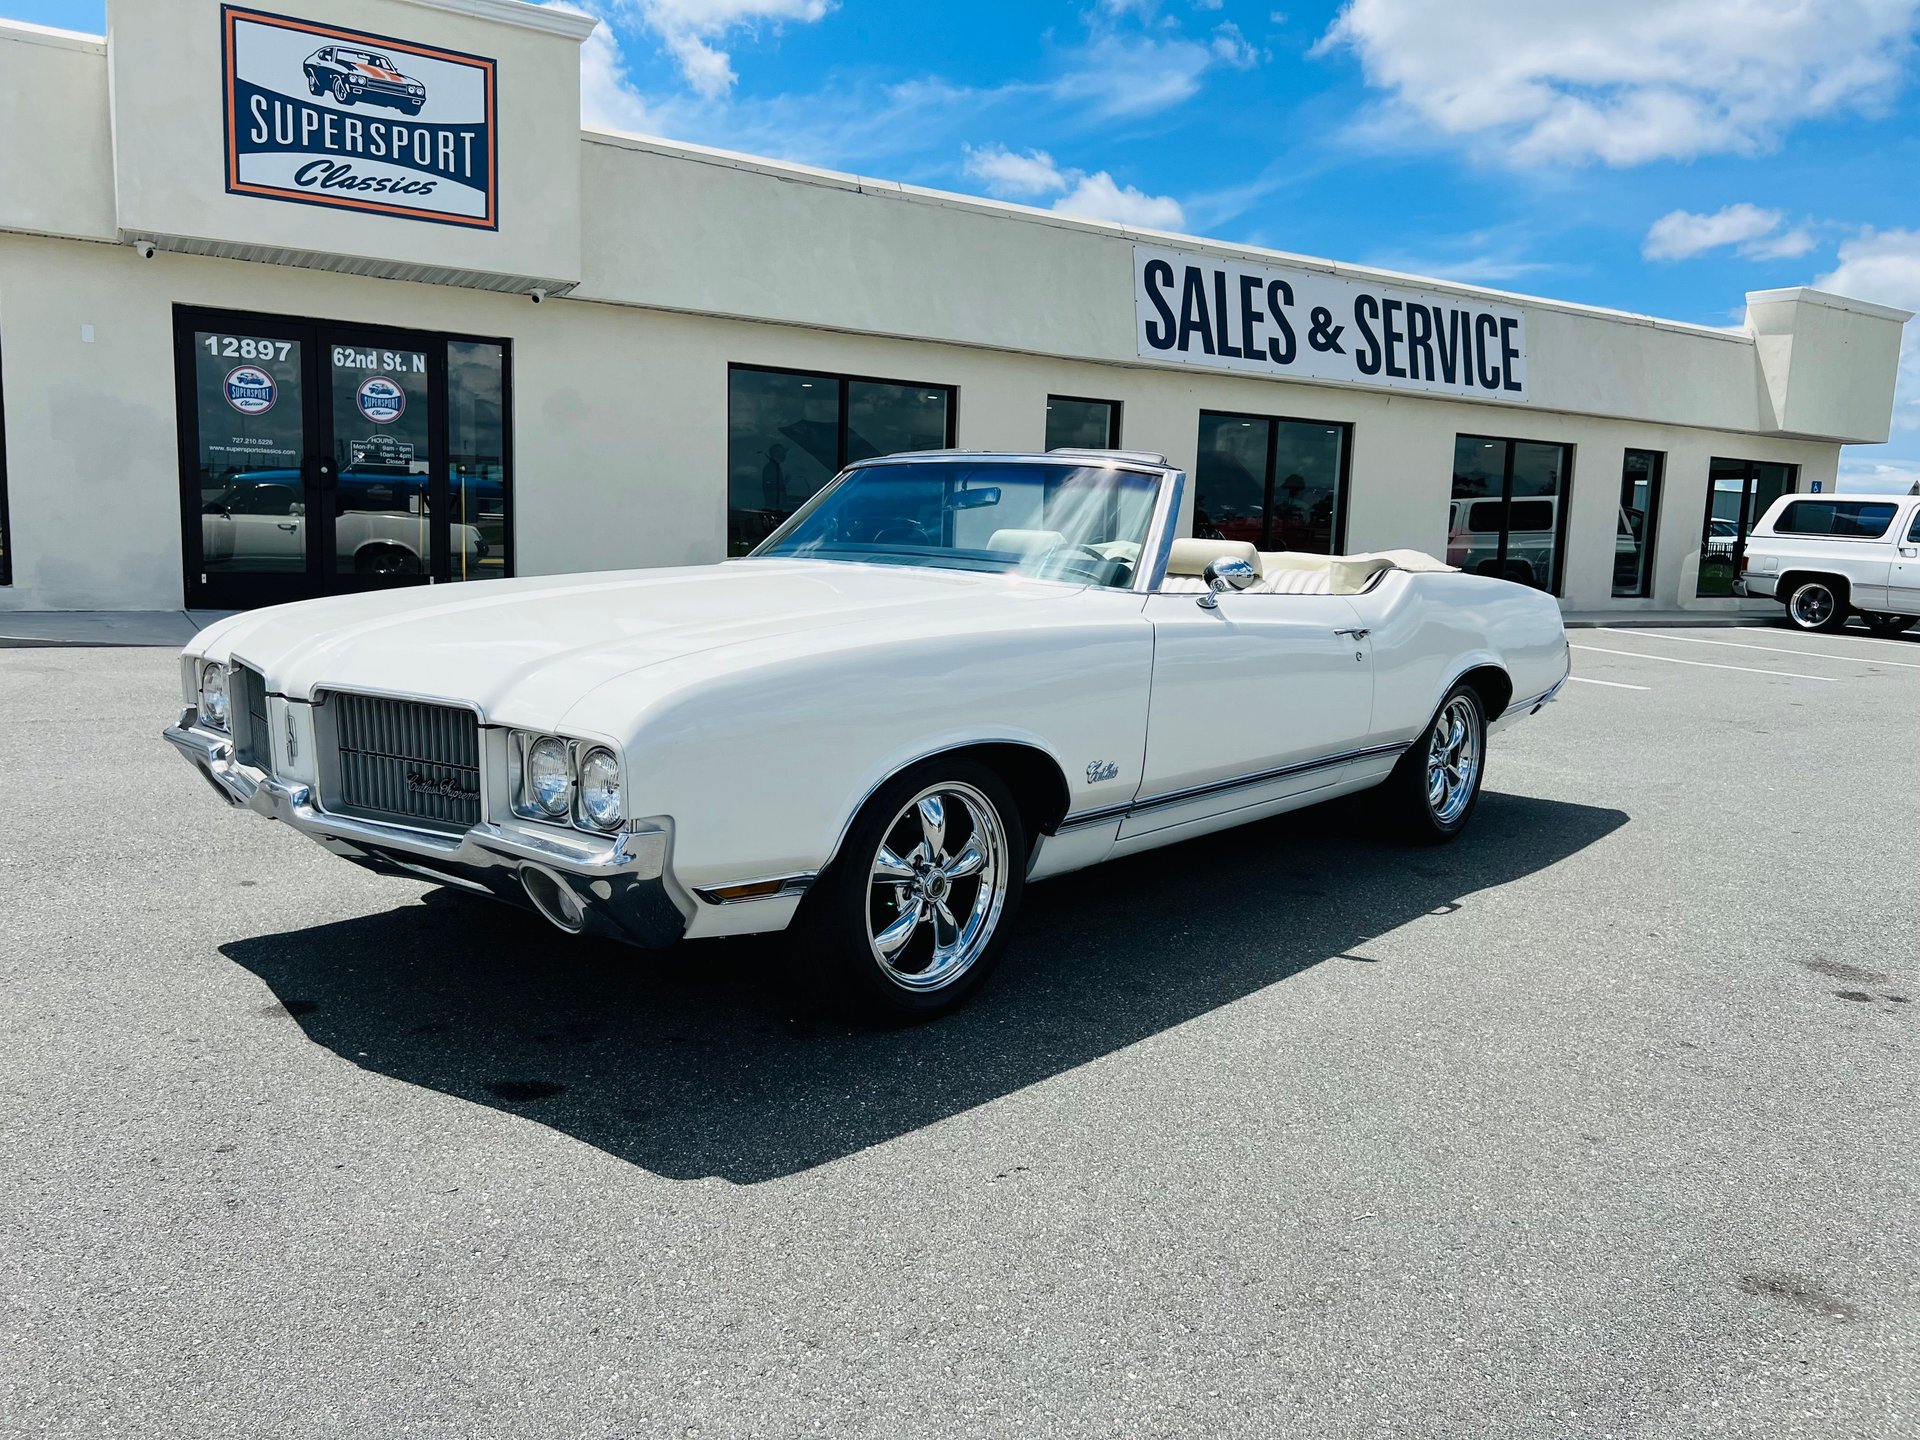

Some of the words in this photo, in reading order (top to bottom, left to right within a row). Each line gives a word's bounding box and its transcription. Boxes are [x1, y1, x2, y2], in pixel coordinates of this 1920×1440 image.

[250, 94, 476, 178] SUPERSPORT
[294, 159, 438, 196] Classics
[1144, 259, 1297, 365] SALES
[1308, 306, 1347, 355] &
[1354, 294, 1522, 392] SERVICE
[205, 335, 291, 361] 12897
[333, 347, 377, 369] 62nd
[383, 352, 407, 372] St.
[412, 354, 425, 373] N
[231, 385, 269, 400] SUPERSPORT
[364, 396, 399, 409] SUPERSPORT
[209, 445, 296, 455] www.supersportclassics.com
[232, 437, 273, 446] 727.210.5226
